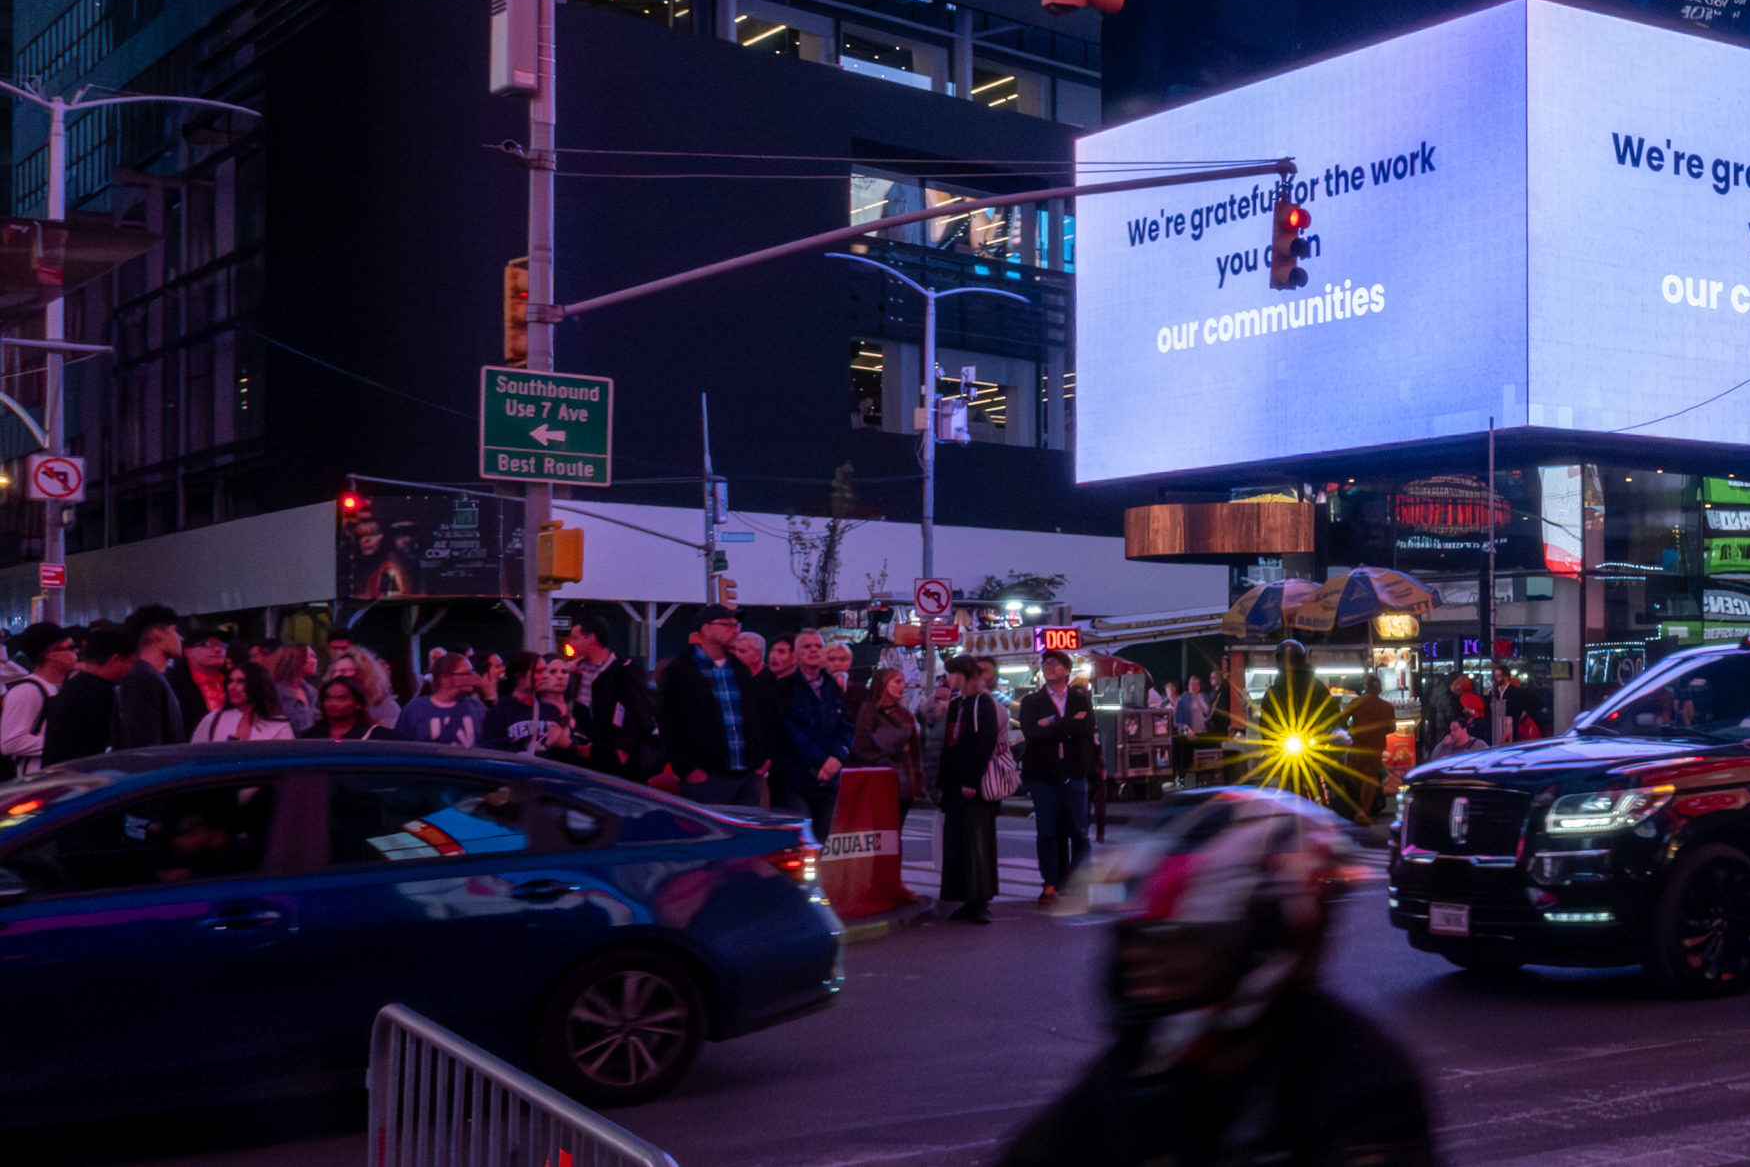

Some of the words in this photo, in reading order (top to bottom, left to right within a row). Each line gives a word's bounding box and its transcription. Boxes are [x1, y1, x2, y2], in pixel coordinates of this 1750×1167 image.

[1612, 132, 1704, 179] We're
[1127, 207, 1186, 247] We're
[1324, 164, 1365, 197] the
[1371, 140, 1436, 186] work
[1216, 247, 1258, 289] you
[1661, 274, 1723, 310] our
[1157, 321, 1199, 353] our
[1203, 279, 1385, 345] communities
[496, 375, 600, 402] Southbound
[506, 398, 536, 418] Use
[541, 401, 552, 419] 7
[558, 403, 589, 422] Ave
[498, 454, 536, 473] Best
[544, 457, 595, 477] Route
[1046, 630, 1077, 650] DOG
